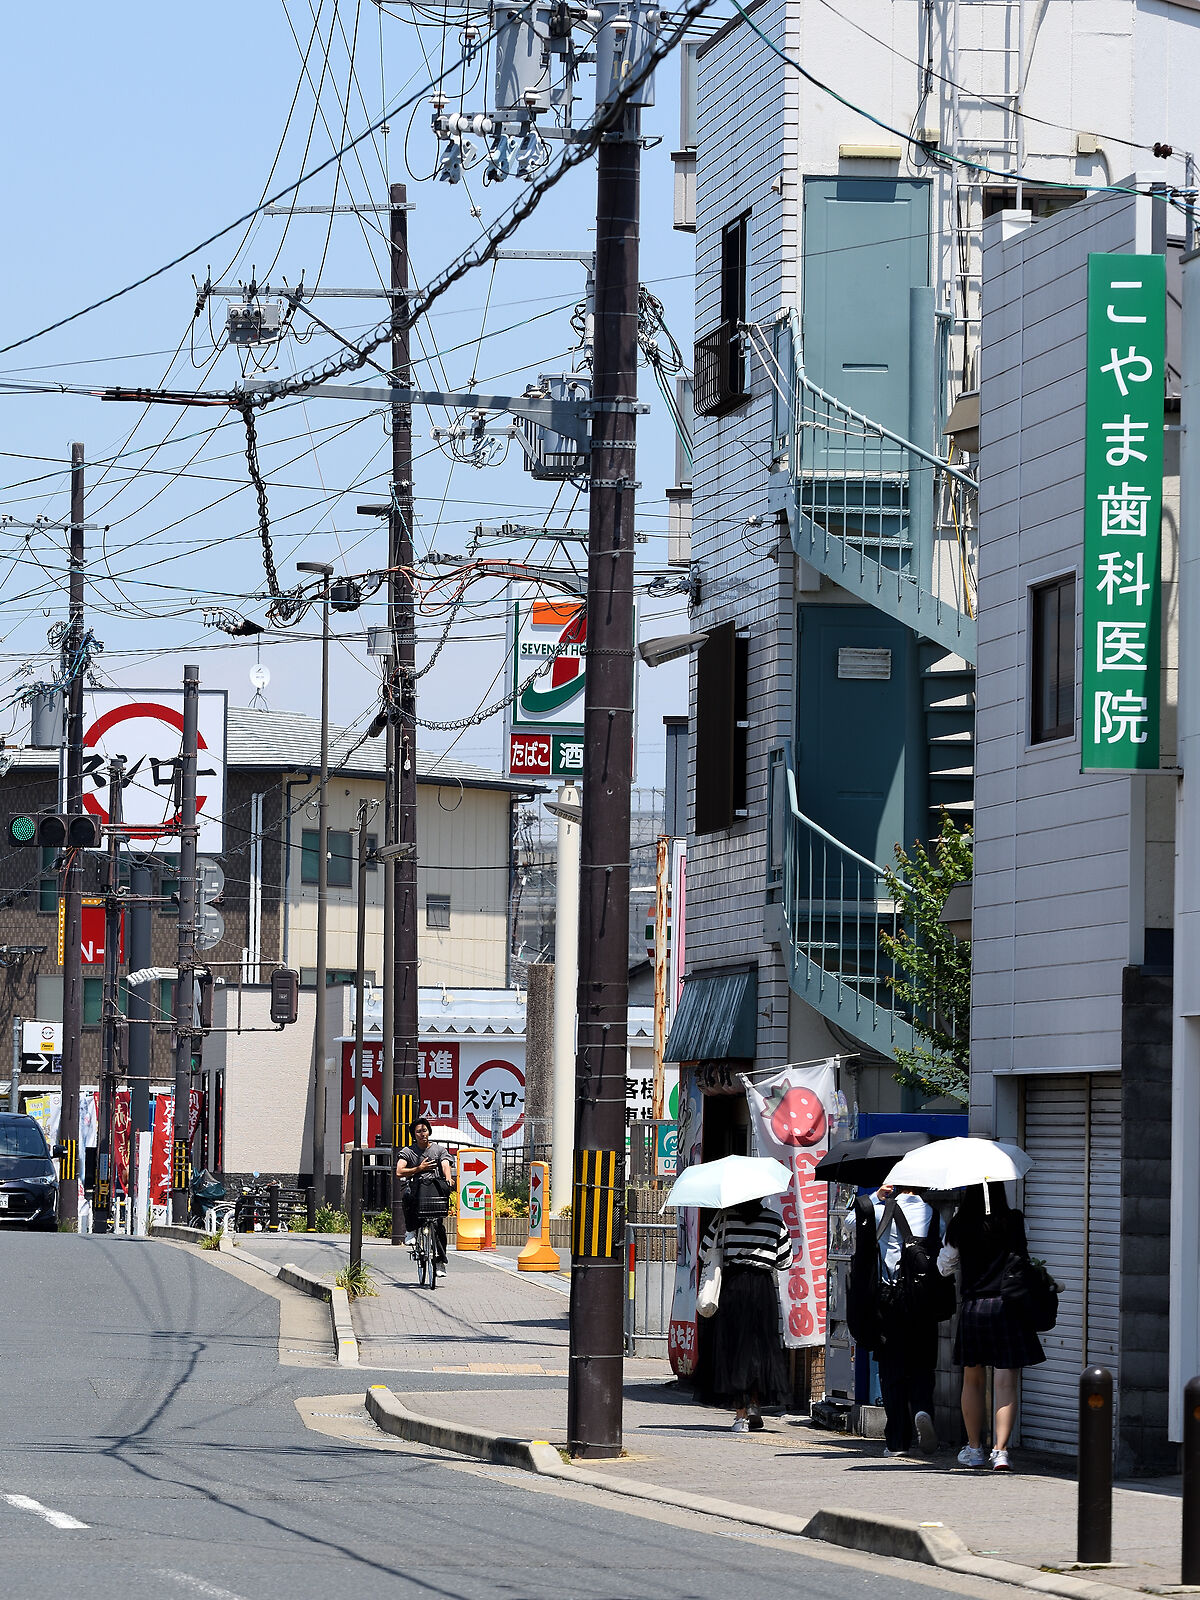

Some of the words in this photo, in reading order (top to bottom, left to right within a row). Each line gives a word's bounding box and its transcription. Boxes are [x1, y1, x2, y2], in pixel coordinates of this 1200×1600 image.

[1093, 280, 1153, 745] こやま歯科医院
[511, 740, 550, 767] たばこ
[559, 742, 585, 769] 酒
[350, 1049, 454, 1080] 信進
